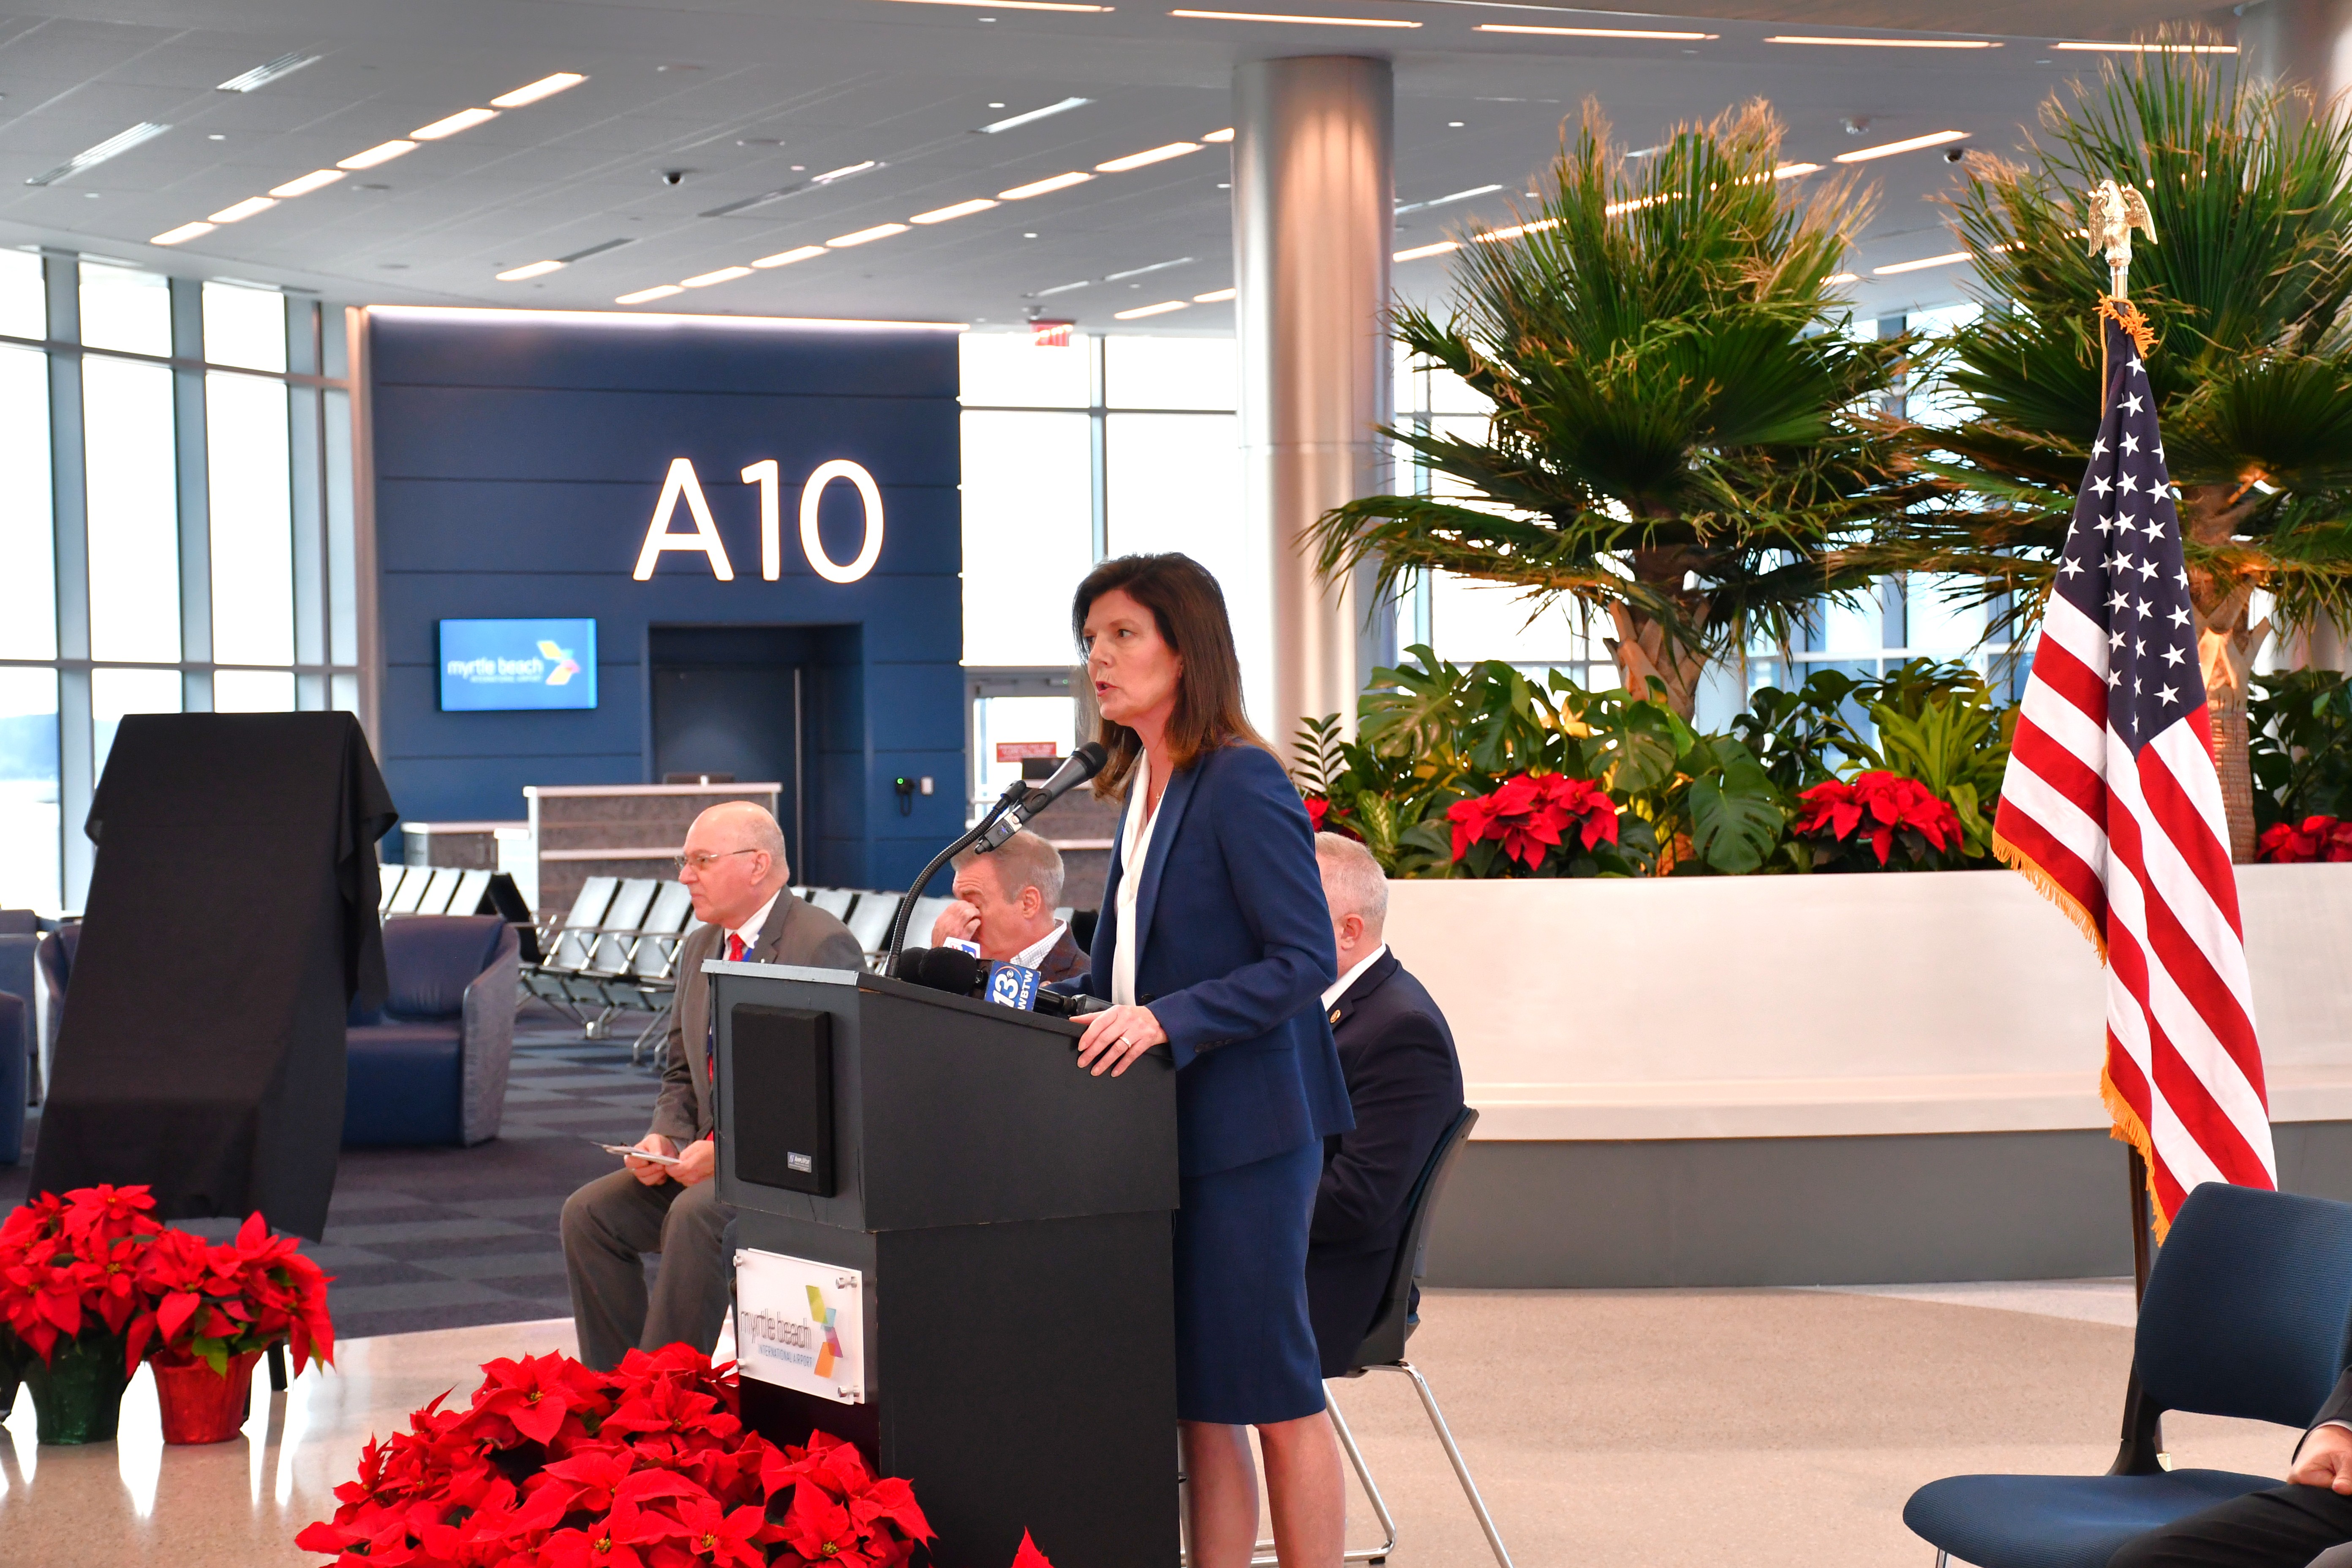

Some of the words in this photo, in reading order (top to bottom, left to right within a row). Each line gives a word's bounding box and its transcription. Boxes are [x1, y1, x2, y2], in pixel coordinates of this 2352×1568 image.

[633, 457, 884, 583] A10
[447, 657, 496, 679] myrtle
[498, 657, 544, 675] beach
[993, 973, 1018, 1007] 13
[1017, 970, 1033, 1010] WBTW
[740, 1308, 775, 1344] myrtle
[777, 1311, 812, 1350] beach
[758, 1345, 792, 1362] INTERNATIONAL
[793, 1353, 812, 1368] AIRPORT
